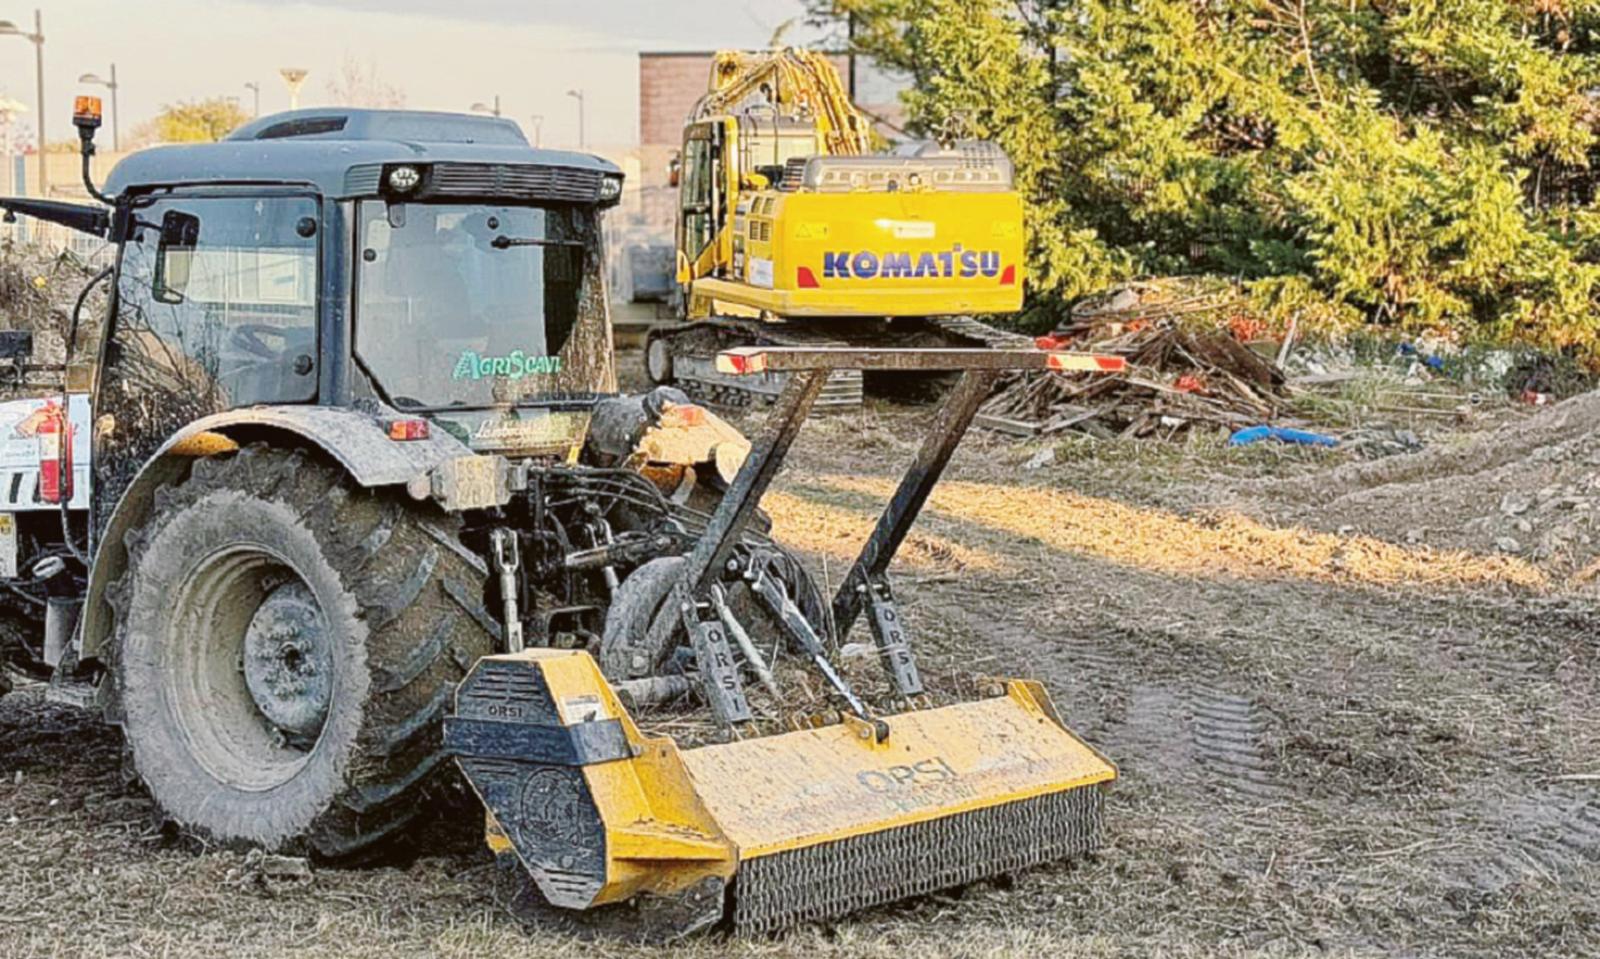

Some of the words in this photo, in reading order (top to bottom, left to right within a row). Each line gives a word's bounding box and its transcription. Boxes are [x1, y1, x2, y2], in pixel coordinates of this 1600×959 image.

[822, 241, 1001, 279] KOMATSU
[883, 609, 914, 687] ORSI
[708, 629, 740, 713] ORSI
[488, 704, 523, 718] ORSI
[856, 756, 957, 793] ORSI
